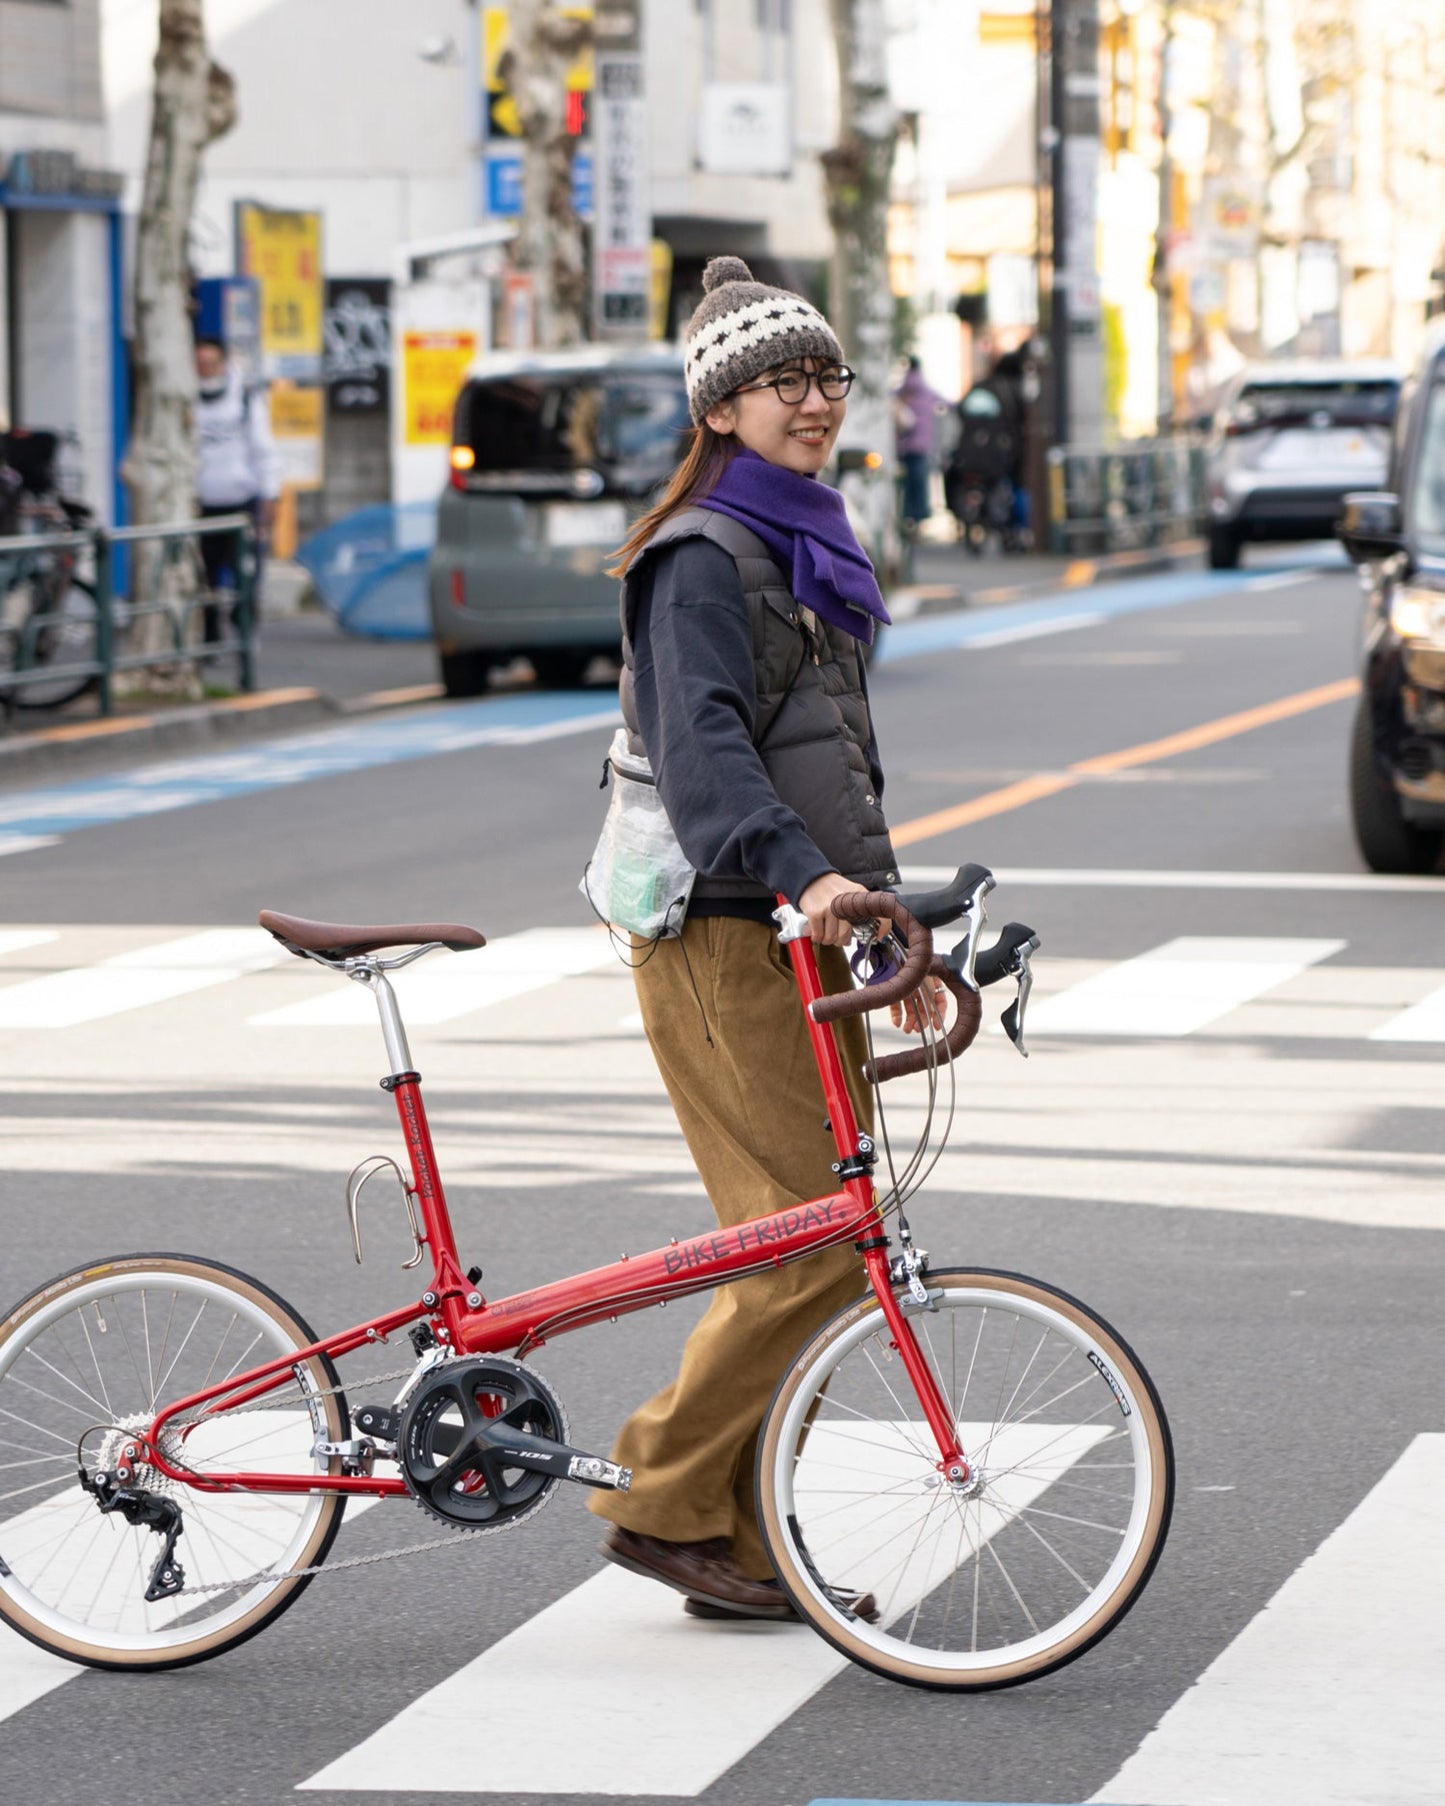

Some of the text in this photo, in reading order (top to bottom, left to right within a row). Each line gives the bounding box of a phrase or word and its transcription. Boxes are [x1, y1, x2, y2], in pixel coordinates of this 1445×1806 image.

[402, 1095, 434, 1199] Pocket Rocket
[664, 1234, 730, 1274] BIKE
[519, 1451, 553, 1460] 105
